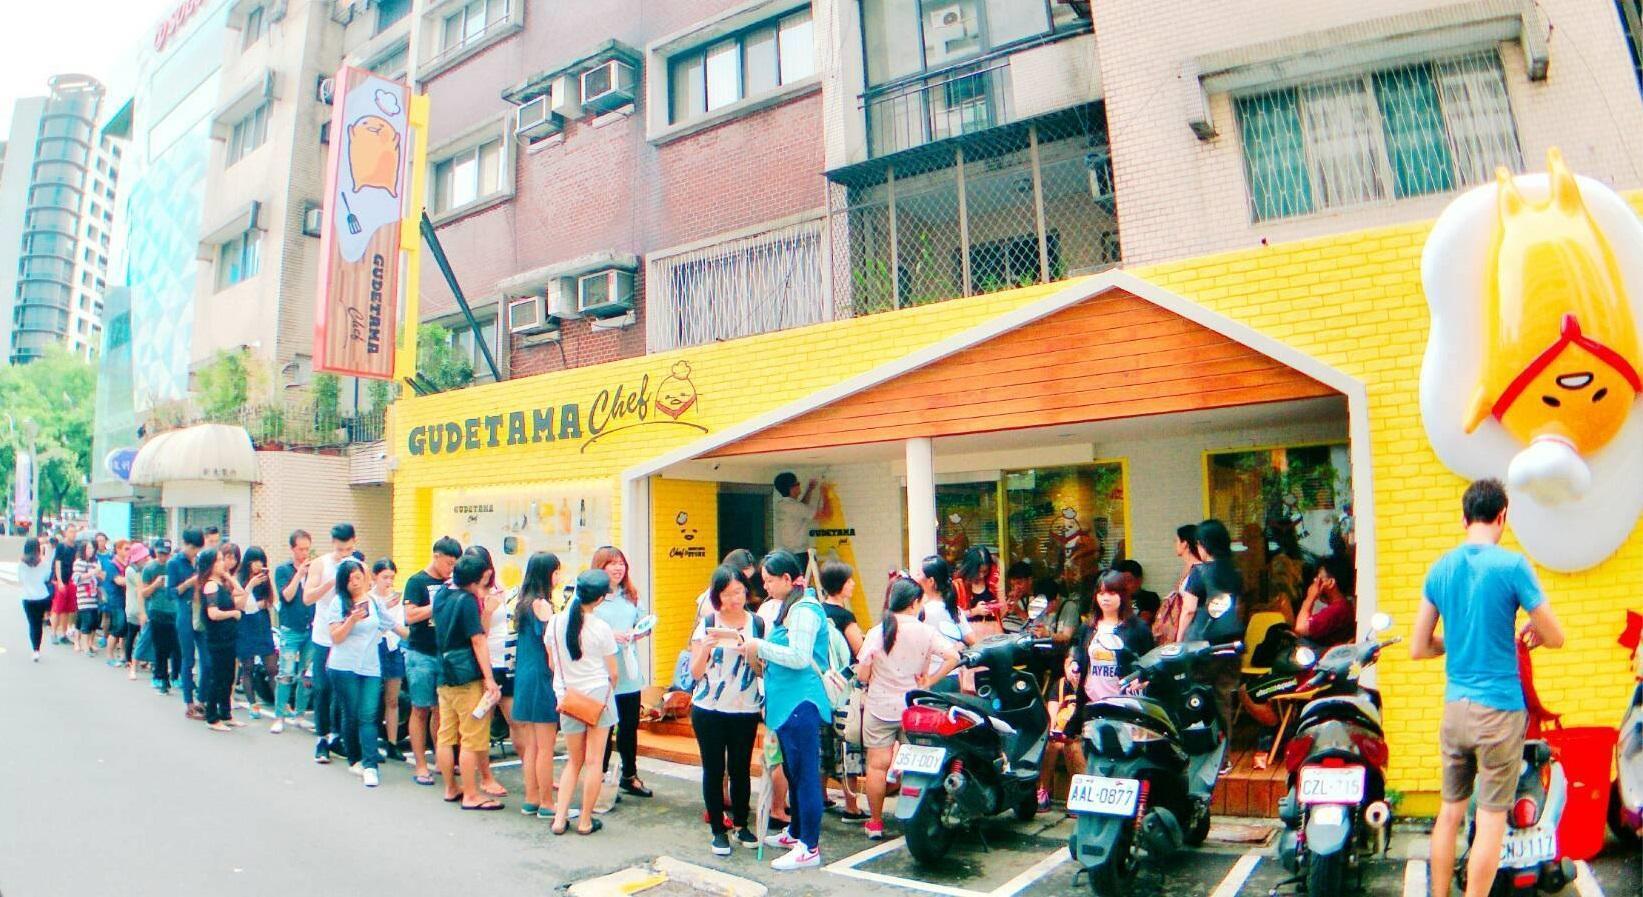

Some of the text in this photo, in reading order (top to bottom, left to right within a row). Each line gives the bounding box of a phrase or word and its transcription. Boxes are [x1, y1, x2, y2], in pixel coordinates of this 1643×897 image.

[367, 253, 385, 354] GUDETAMA
[347, 306, 367, 342] Chef
[408, 374, 652, 456] GUDETAMA Chef
[453, 504, 494, 513] GUDETAMA
[808, 528, 856, 537] GUDETAMA
[1070, 785, 1134, 806] AAL-0877
